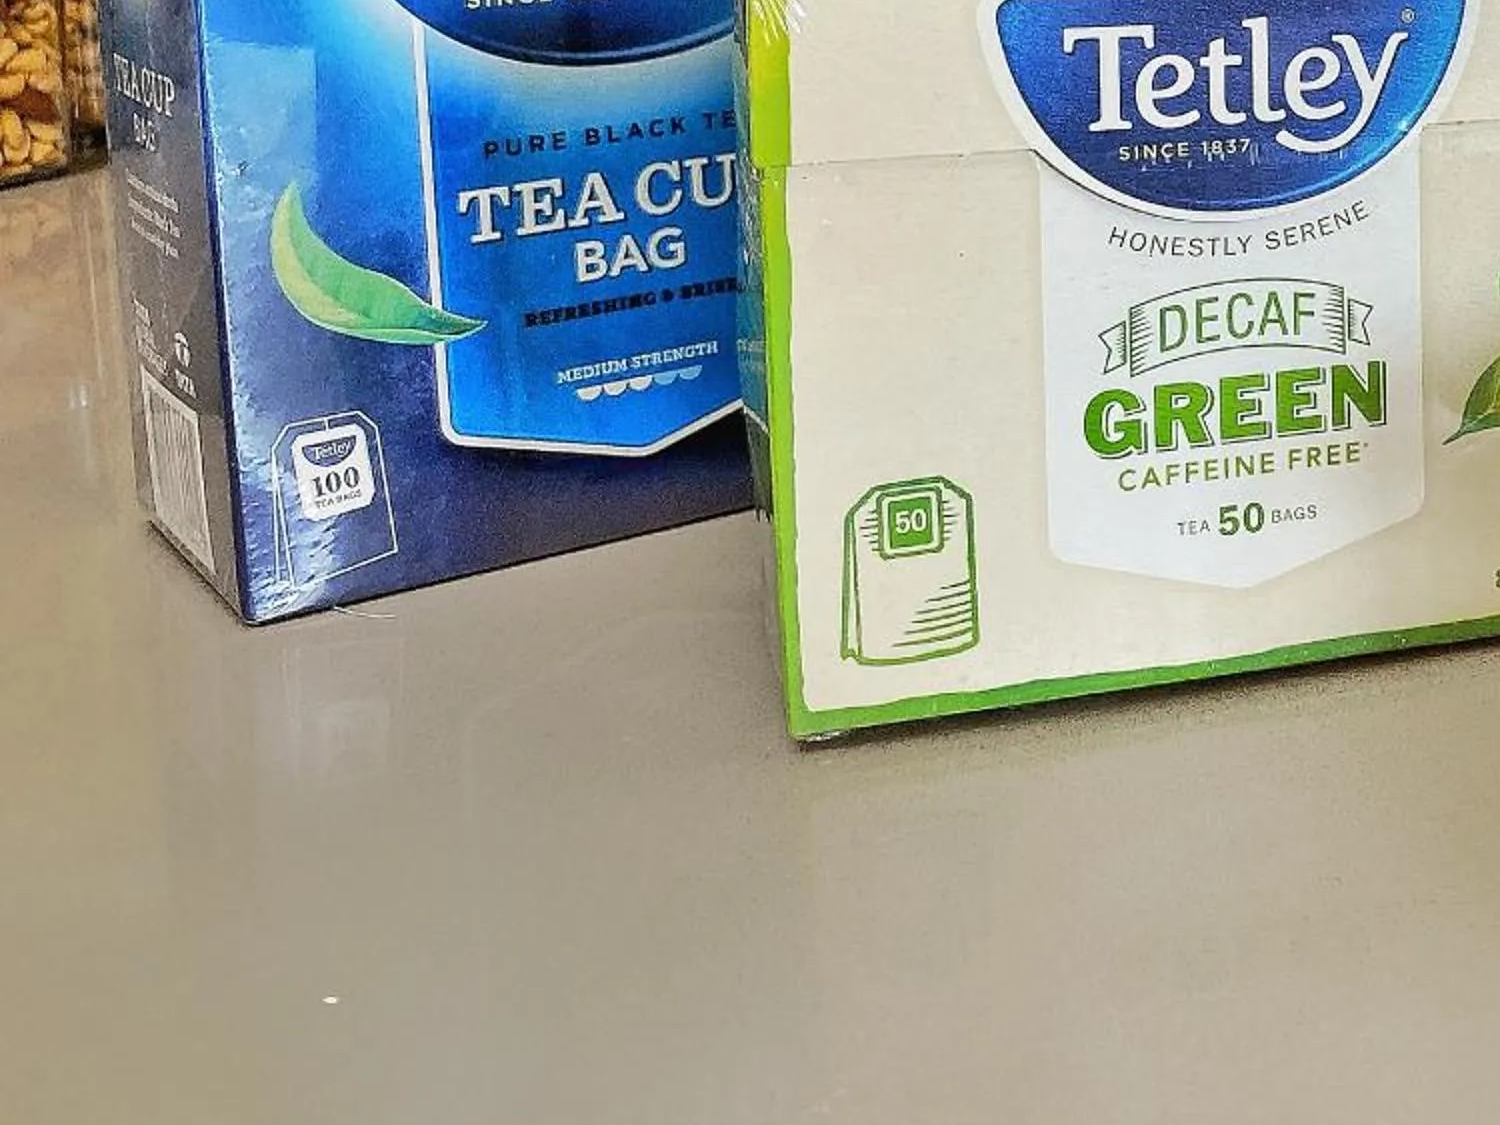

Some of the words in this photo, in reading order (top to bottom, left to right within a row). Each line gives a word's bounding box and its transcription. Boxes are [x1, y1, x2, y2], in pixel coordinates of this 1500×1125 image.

[1062, 15, 1409, 154] Tetley
[483, 131, 568, 160] PURE
[584, 116, 687, 147] BLACK
[703, 109, 737, 130] TE
[1118, 142, 1190, 161] SINCE
[1200, 138, 1251, 157] 1837
[458, 171, 625, 244] TEA
[636, 153, 737, 216] CU
[1107, 225, 1254, 258] HONESTLY
[1264, 200, 1373, 252] SERENE
[574, 226, 687, 283] BAG
[523, 291, 657, 328] REFRESHING
[1158, 290, 1317, 354] DECAF
[556, 359, 628, 385] MEDIUM
[628, 340, 719, 368] STRENGTH
[1083, 359, 1388, 460] GREEN
[312, 466, 360, 497] 100
[1118, 451, 1276, 492] CAFFEINE
[895, 508, 927, 534] 50
[1176, 521, 1211, 537] TEA
[1218, 502, 1266, 537] 50
[1270, 504, 1318, 524] BAGS
